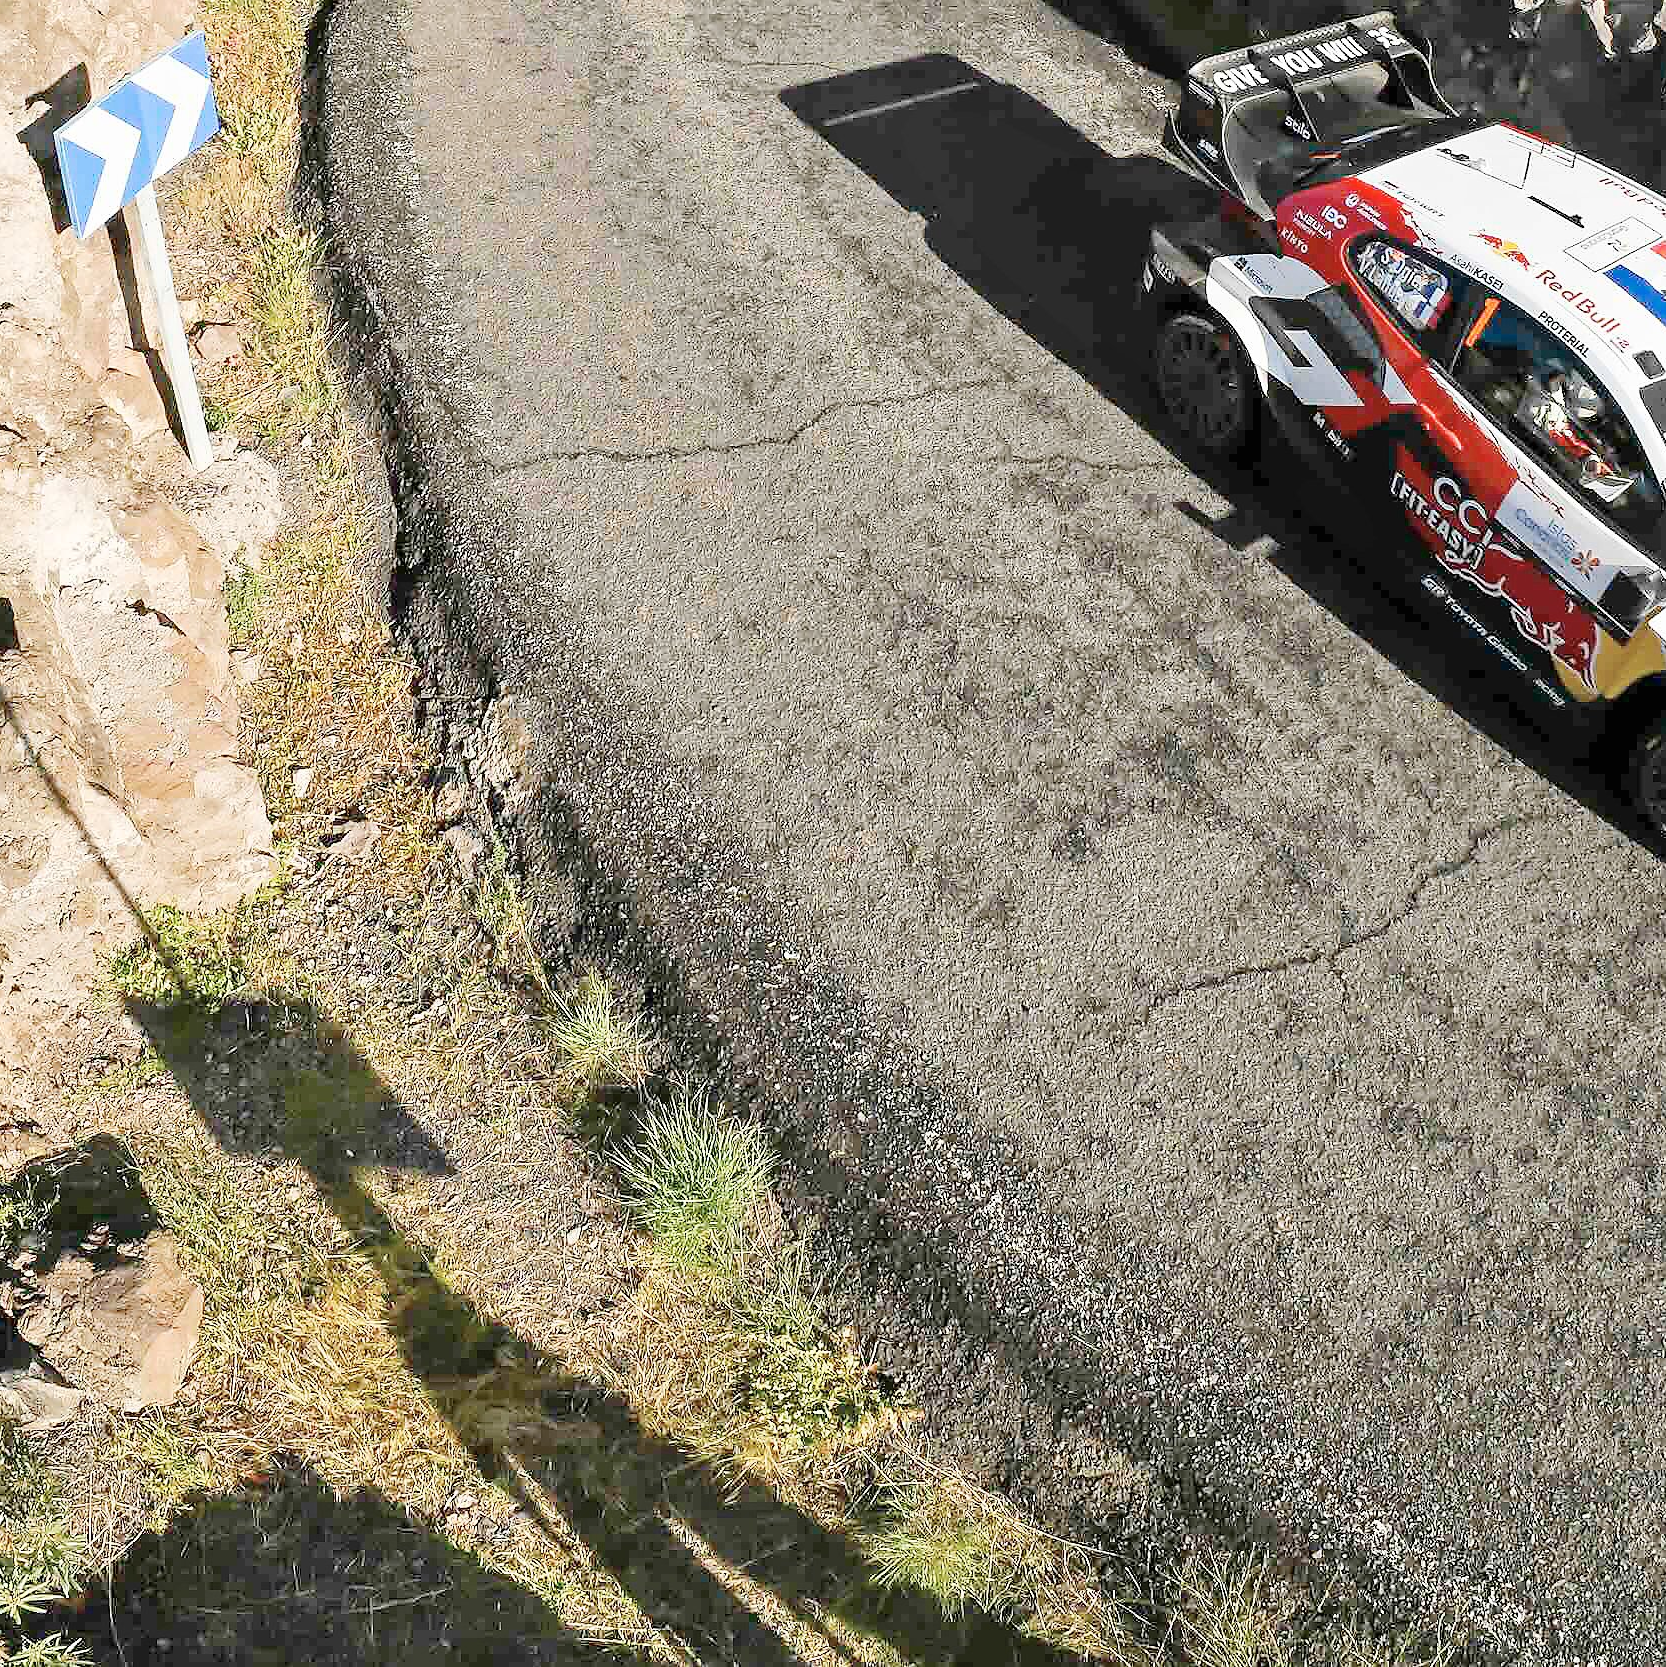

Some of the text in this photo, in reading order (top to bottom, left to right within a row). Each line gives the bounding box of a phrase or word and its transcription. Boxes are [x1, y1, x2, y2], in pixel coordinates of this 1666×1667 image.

[1270, 47, 1322, 76] YOU
[1449, 253, 1504, 290] AsahiKASEI
[1538, 311, 1590, 358] PROTERIAL
[1445, 594, 1487, 636] TOYOTA
[1533, 677, 1566, 708] acing
